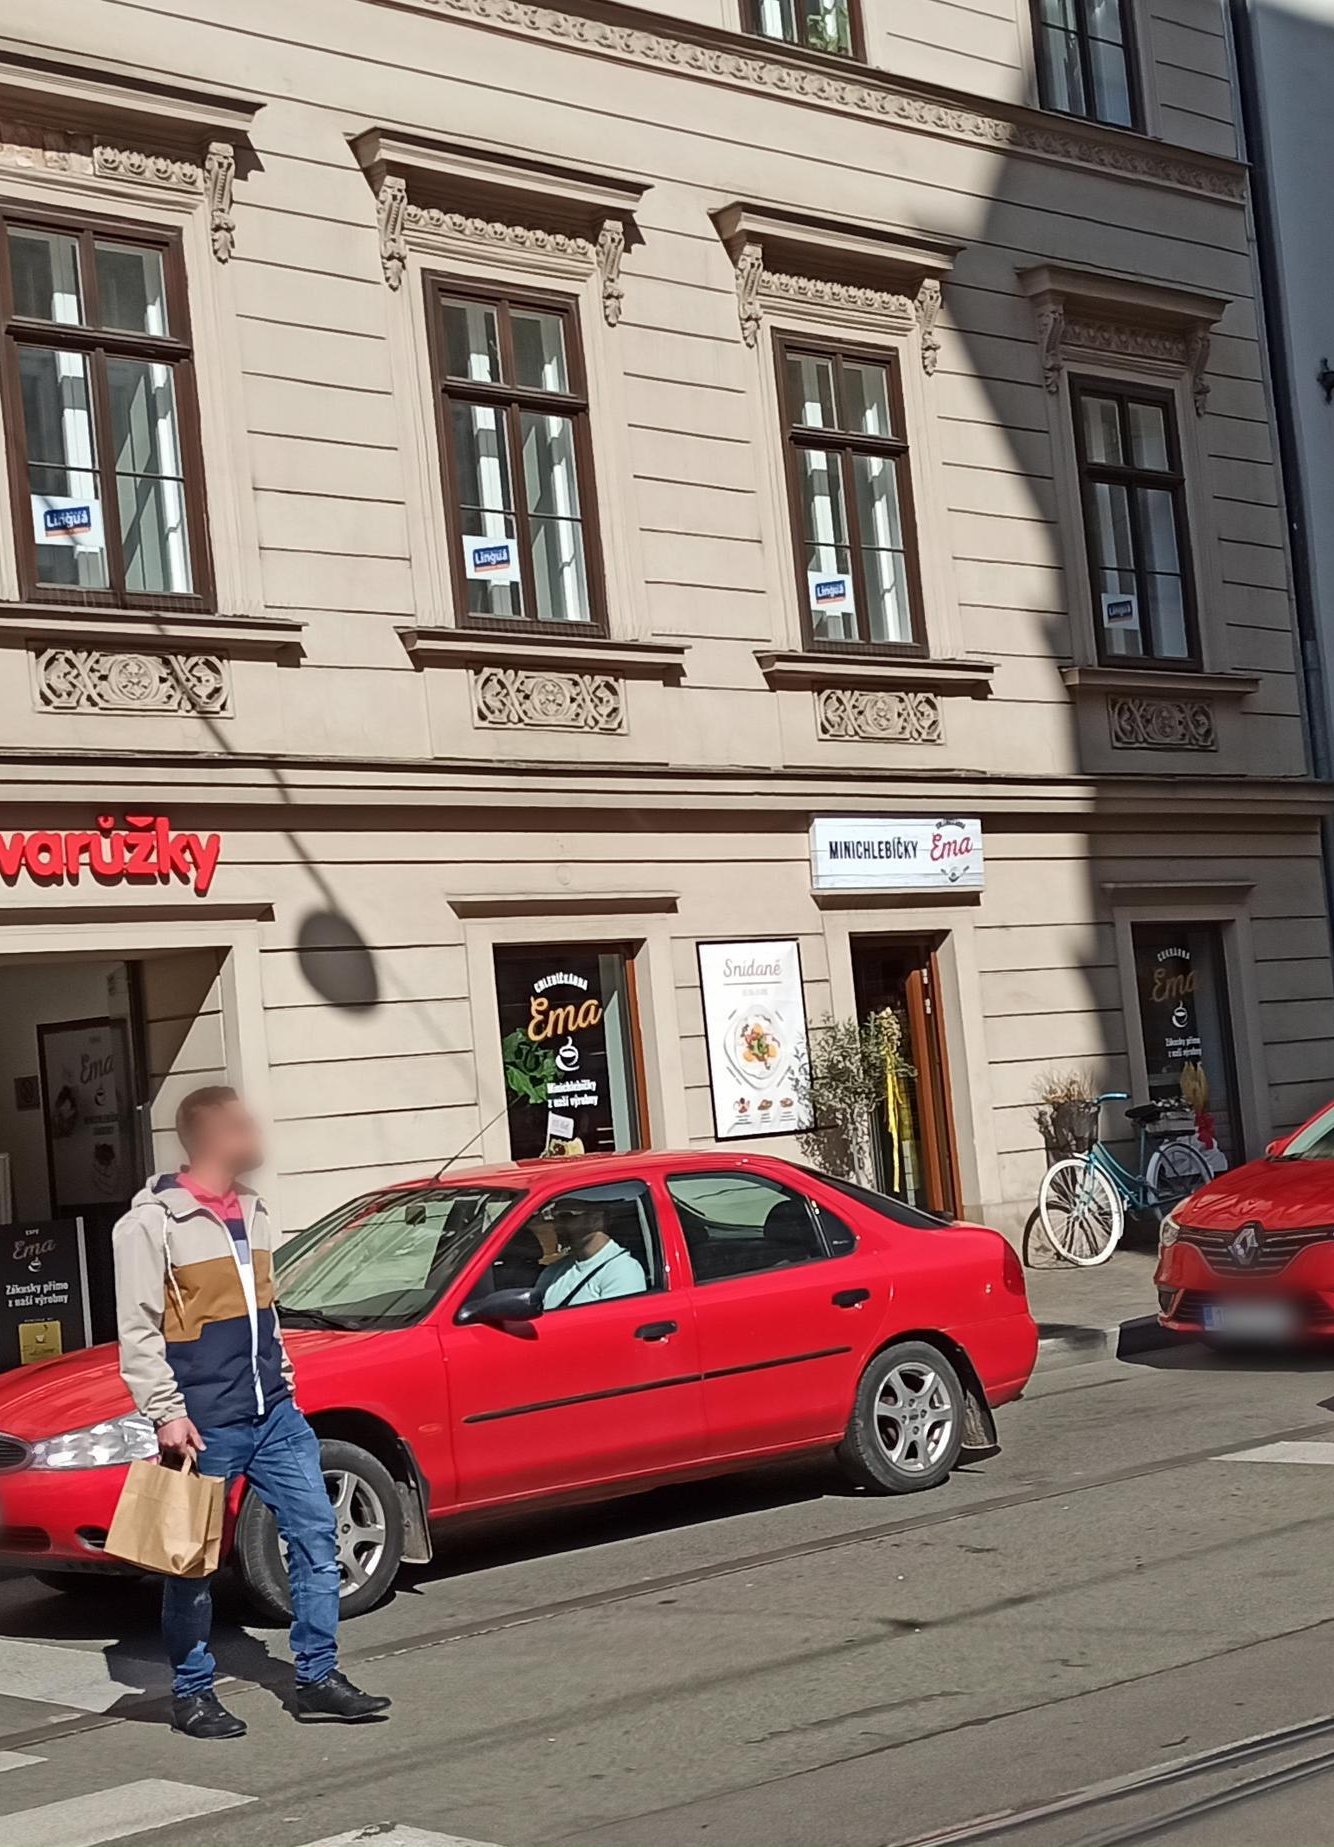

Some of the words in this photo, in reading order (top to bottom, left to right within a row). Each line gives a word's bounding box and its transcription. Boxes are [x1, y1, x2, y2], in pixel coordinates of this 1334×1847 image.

[828, 836, 919, 861] MINICHLEBÍČKY
[929, 832, 975, 862] Ema
[1152, 968, 1199, 1003] Ema
[527, 996, 603, 1042] Ema
[80, 1053, 115, 1085] Ema
[12, 1239, 56, 1260] Ema
